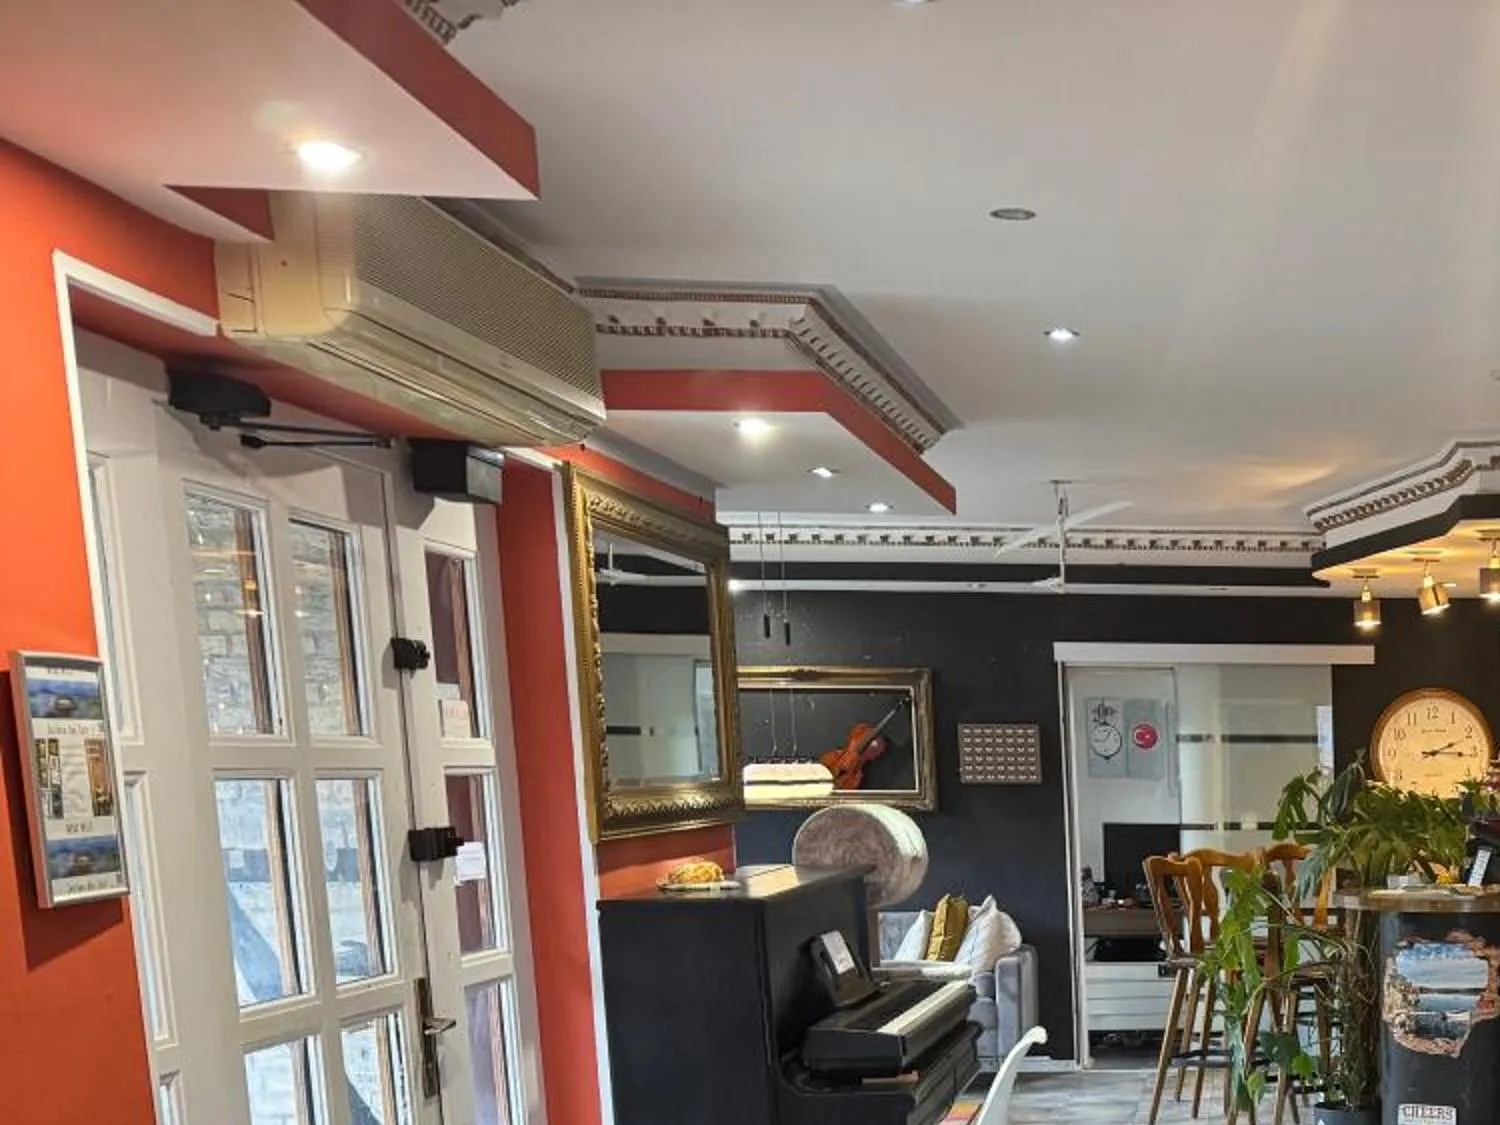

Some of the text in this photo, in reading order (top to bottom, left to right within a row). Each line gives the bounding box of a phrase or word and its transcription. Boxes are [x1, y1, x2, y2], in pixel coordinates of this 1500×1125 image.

[1407, 711, 1417, 725] 11
[1426, 705, 1439, 720] 12
[1464, 724, 1473, 739] 2
